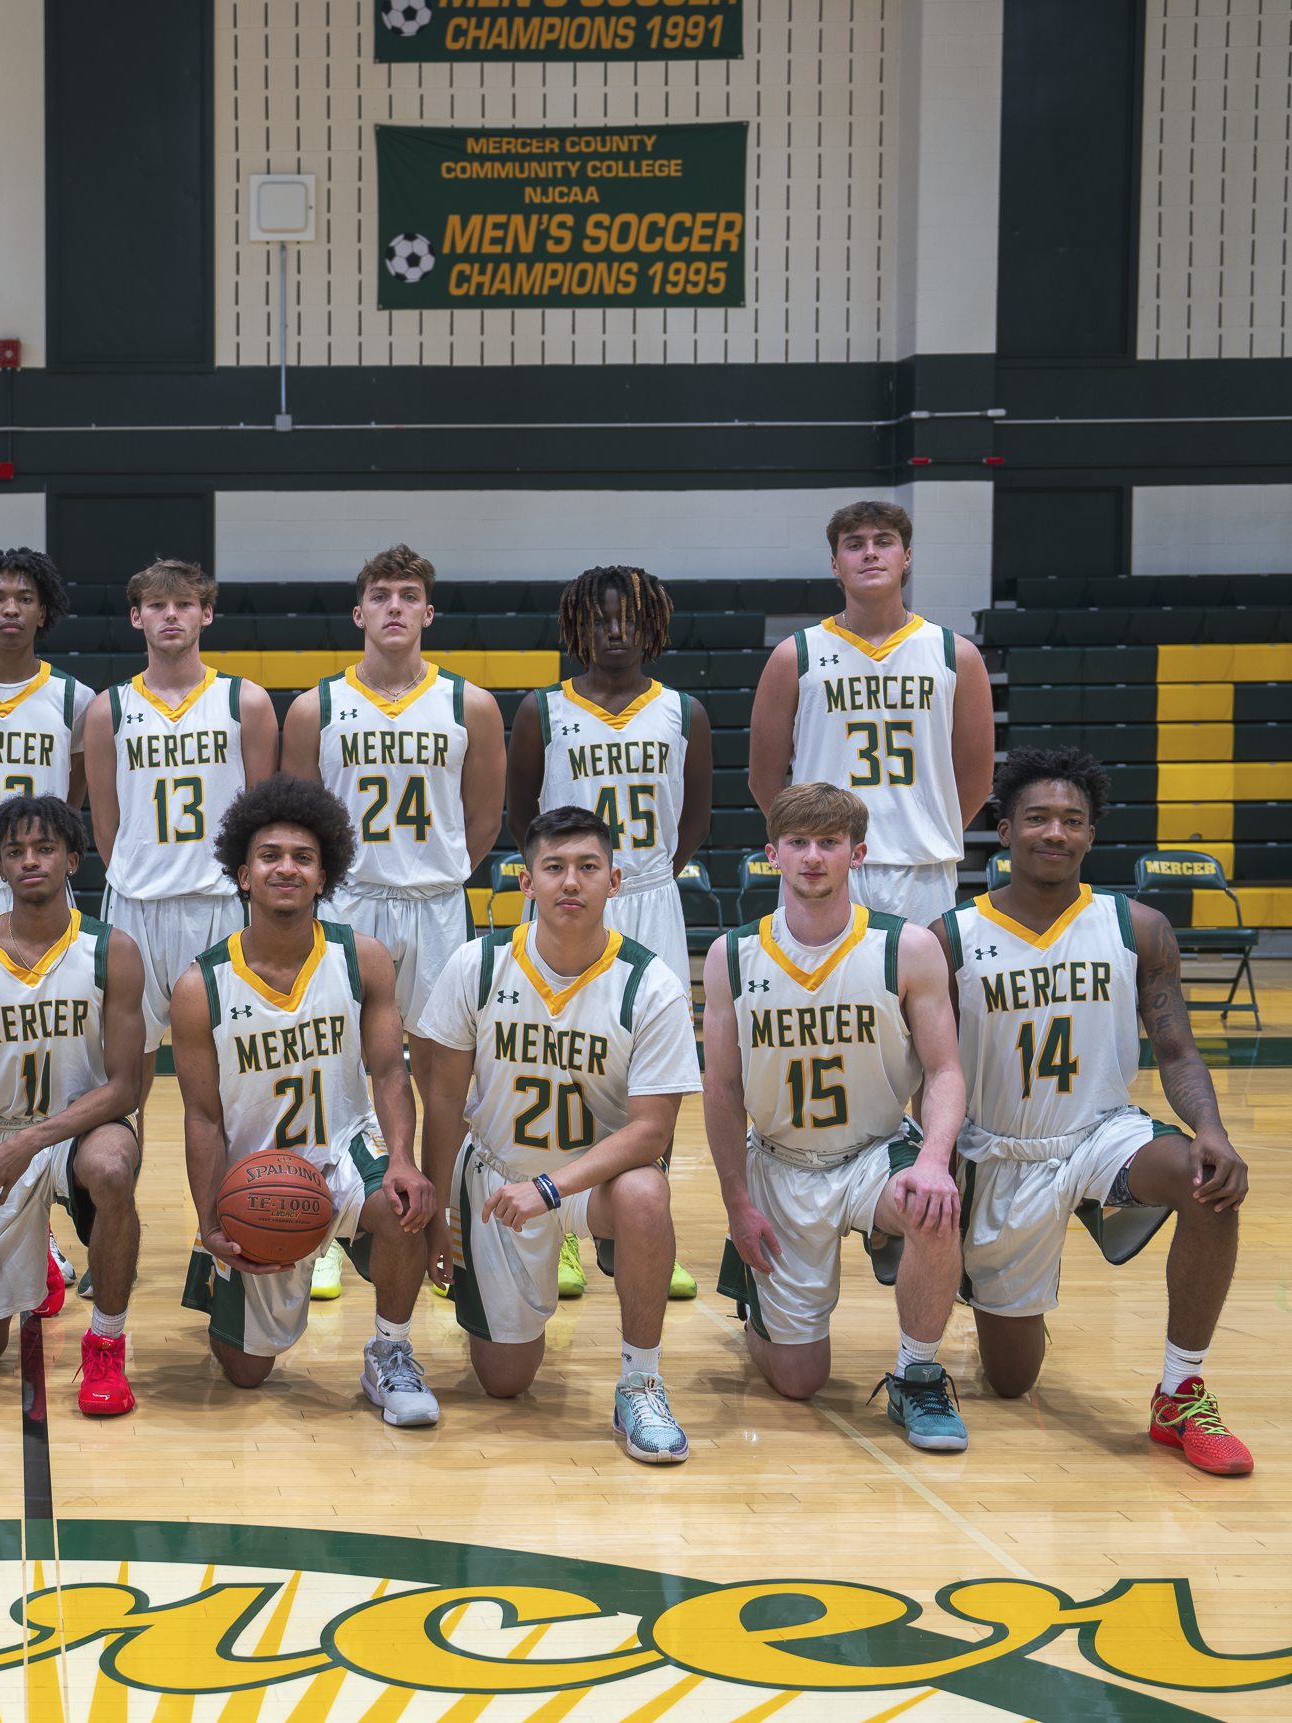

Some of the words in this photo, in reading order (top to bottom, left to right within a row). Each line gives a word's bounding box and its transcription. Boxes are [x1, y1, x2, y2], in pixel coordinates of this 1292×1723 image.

[445, 15, 636, 50] CHAMPIONS
[646, 14, 724, 49] 1991
[466, 136, 559, 154] MERCER
[565, 135, 657, 153] COUNTY
[441, 161, 581, 179] COMMUNITY
[586, 159, 683, 177] COLLEGE
[524, 186, 600, 204] NJCAA
[442, 213, 575, 254] MEN'S
[583, 212, 743, 253] SOCCER
[448, 261, 639, 296] CHAMPIONS
[647, 261, 728, 295] 1995
[823, 675, 935, 714] MERCER
[126, 730, 228, 771] MERCER
[340, 730, 449, 768] MERCER
[568, 741, 670, 781] MERCER
[845, 719, 916, 789] 35
[152, 775, 205, 845] 13
[357, 775, 433, 844] 24
[594, 783, 657, 851] 45
[1145, 860, 1216, 875] MERCER
[981, 961, 1111, 1015] MERCER
[233, 1014, 345, 1076] MERCER
[750, 1003, 876, 1049] MERCER
[494, 1020, 608, 1076] MERCER
[1015, 1014, 1079, 1101] 14
[20, 1049, 52, 1117] 11
[785, 1053, 850, 1130] 15
[273, 1068, 329, 1150] 21
[512, 1074, 596, 1152] 20
[246, 1164, 322, 1188] SPALDING
[248, 1196, 320, 1212] TF-1000
[270, 1210, 301, 1218] LEGACY
